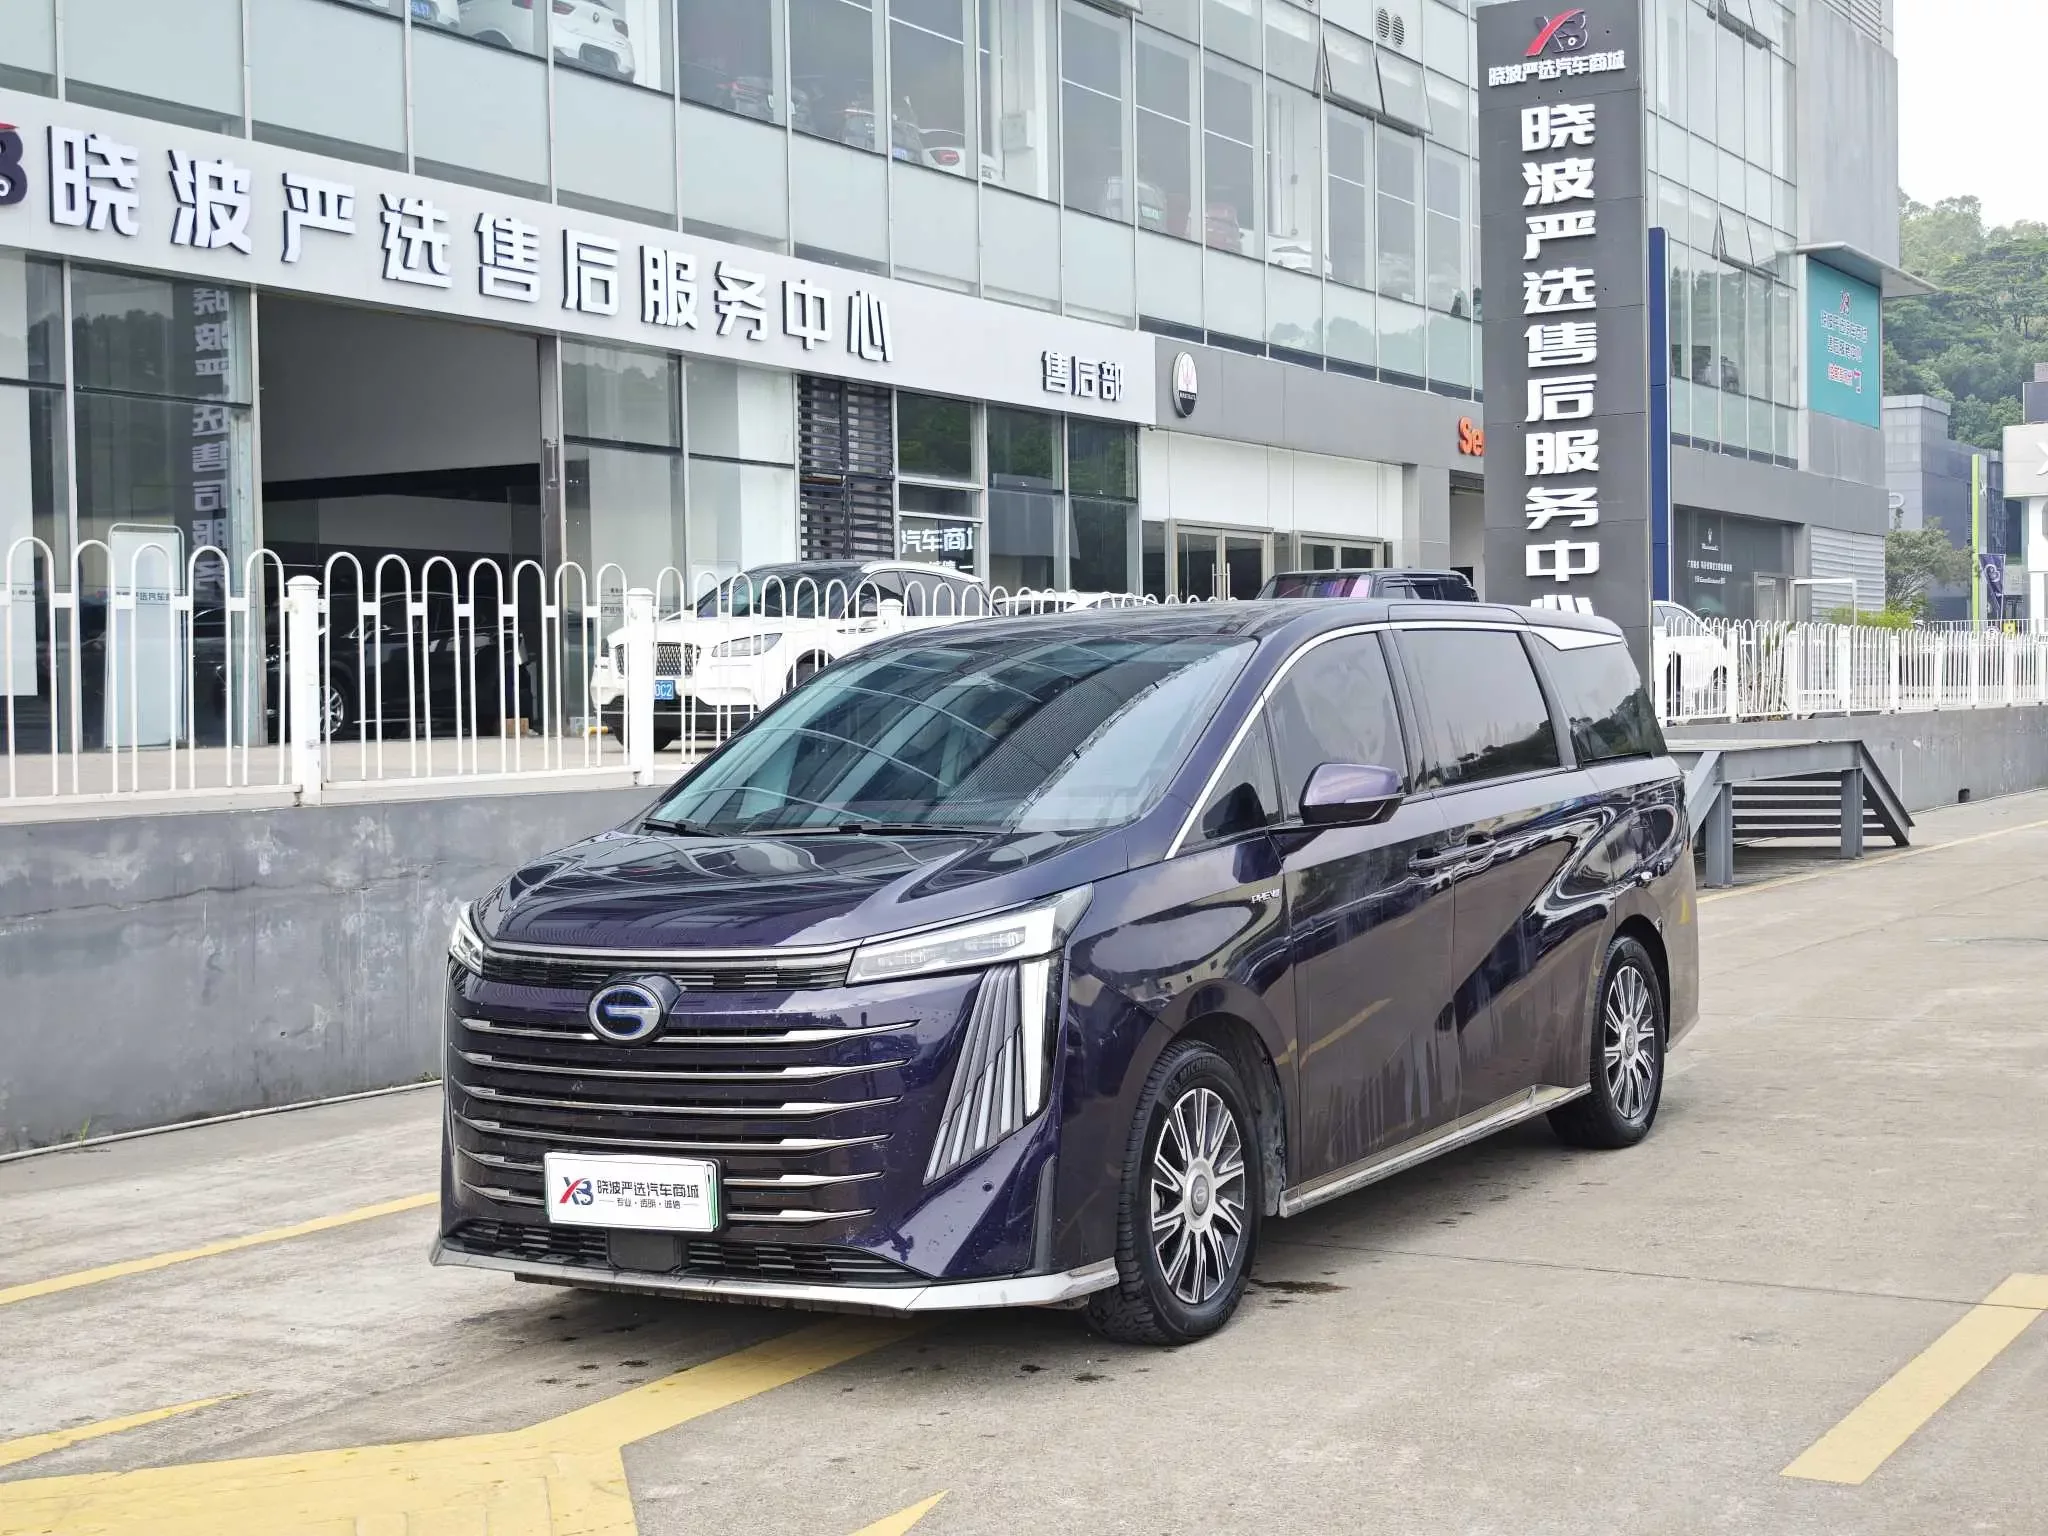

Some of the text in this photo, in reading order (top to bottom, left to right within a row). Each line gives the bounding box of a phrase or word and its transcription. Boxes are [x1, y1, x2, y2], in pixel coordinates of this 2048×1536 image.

[1488, 50, 1626, 87] 晓波严选汽车商城
[47, 124, 892, 363] 晓波严选售后服务中心
[1041, 351, 1125, 401] 售后部
[596, 1179, 700, 1199] 晓波严选汽车商城
